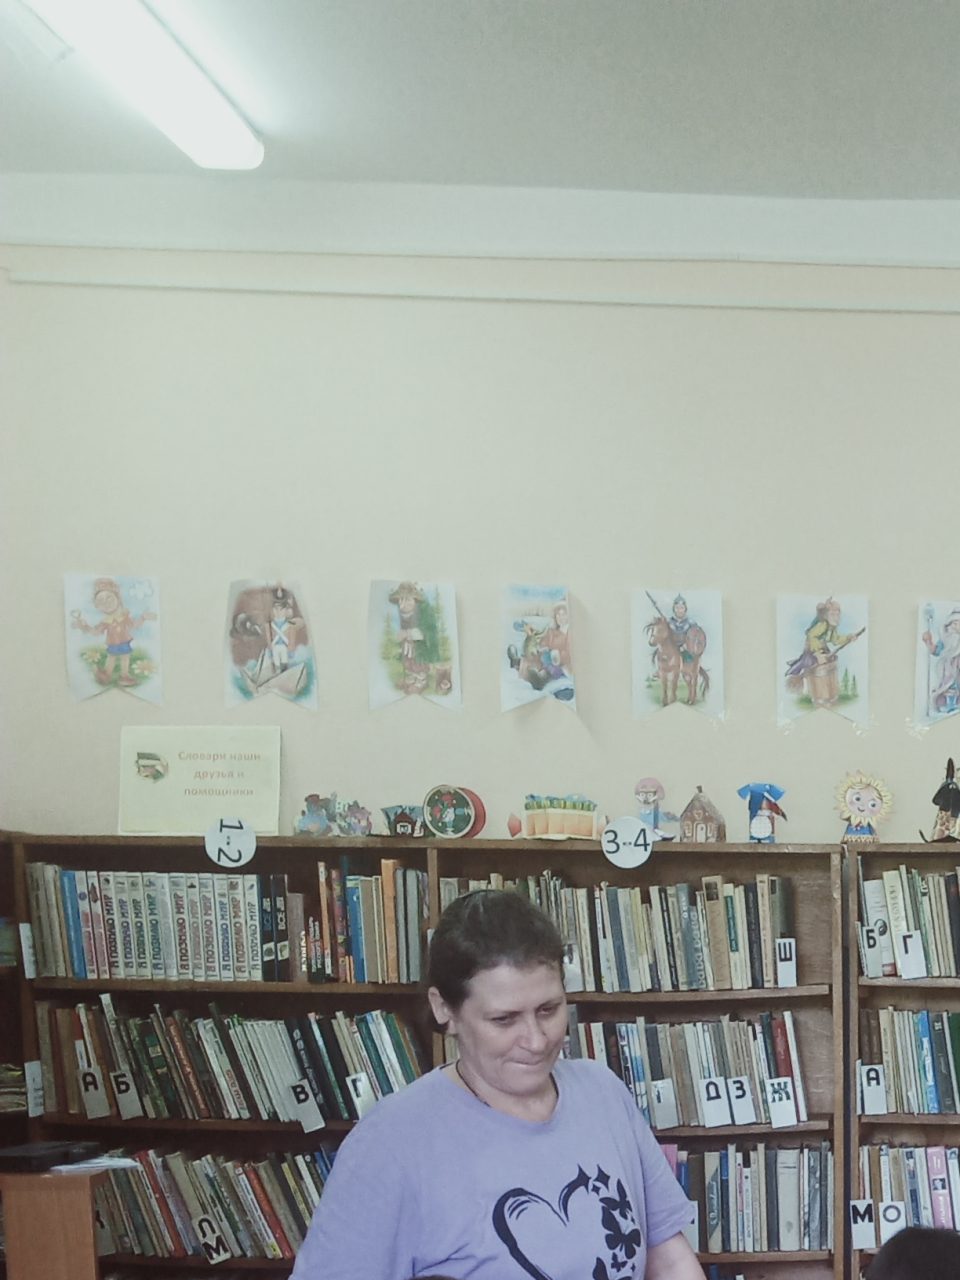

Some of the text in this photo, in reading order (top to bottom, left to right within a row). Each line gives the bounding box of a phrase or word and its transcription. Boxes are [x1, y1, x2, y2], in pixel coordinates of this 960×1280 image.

[178, 751, 261, 762] Словари наши
[194, 770, 234, 780] друзья
[185, 788, 254, 796] помощники
[866, 929, 876, 949] Б
[902, 934, 913, 955] Г
[778, 941, 793, 962] Ш
[82, 1071, 98, 1092] А
[113, 1073, 130, 1094] Б
[866, 1068, 880, 1087] А
[291, 1083, 309, 1104] В
[705, 1081, 722, 1101] Д
[733, 1080, 746, 1099] З
[770, 1081, 791, 1103] Ж
[851, 1203, 873, 1224] М
[882, 1205, 901, 1223] О
[202, 1235, 229, 1260] М
